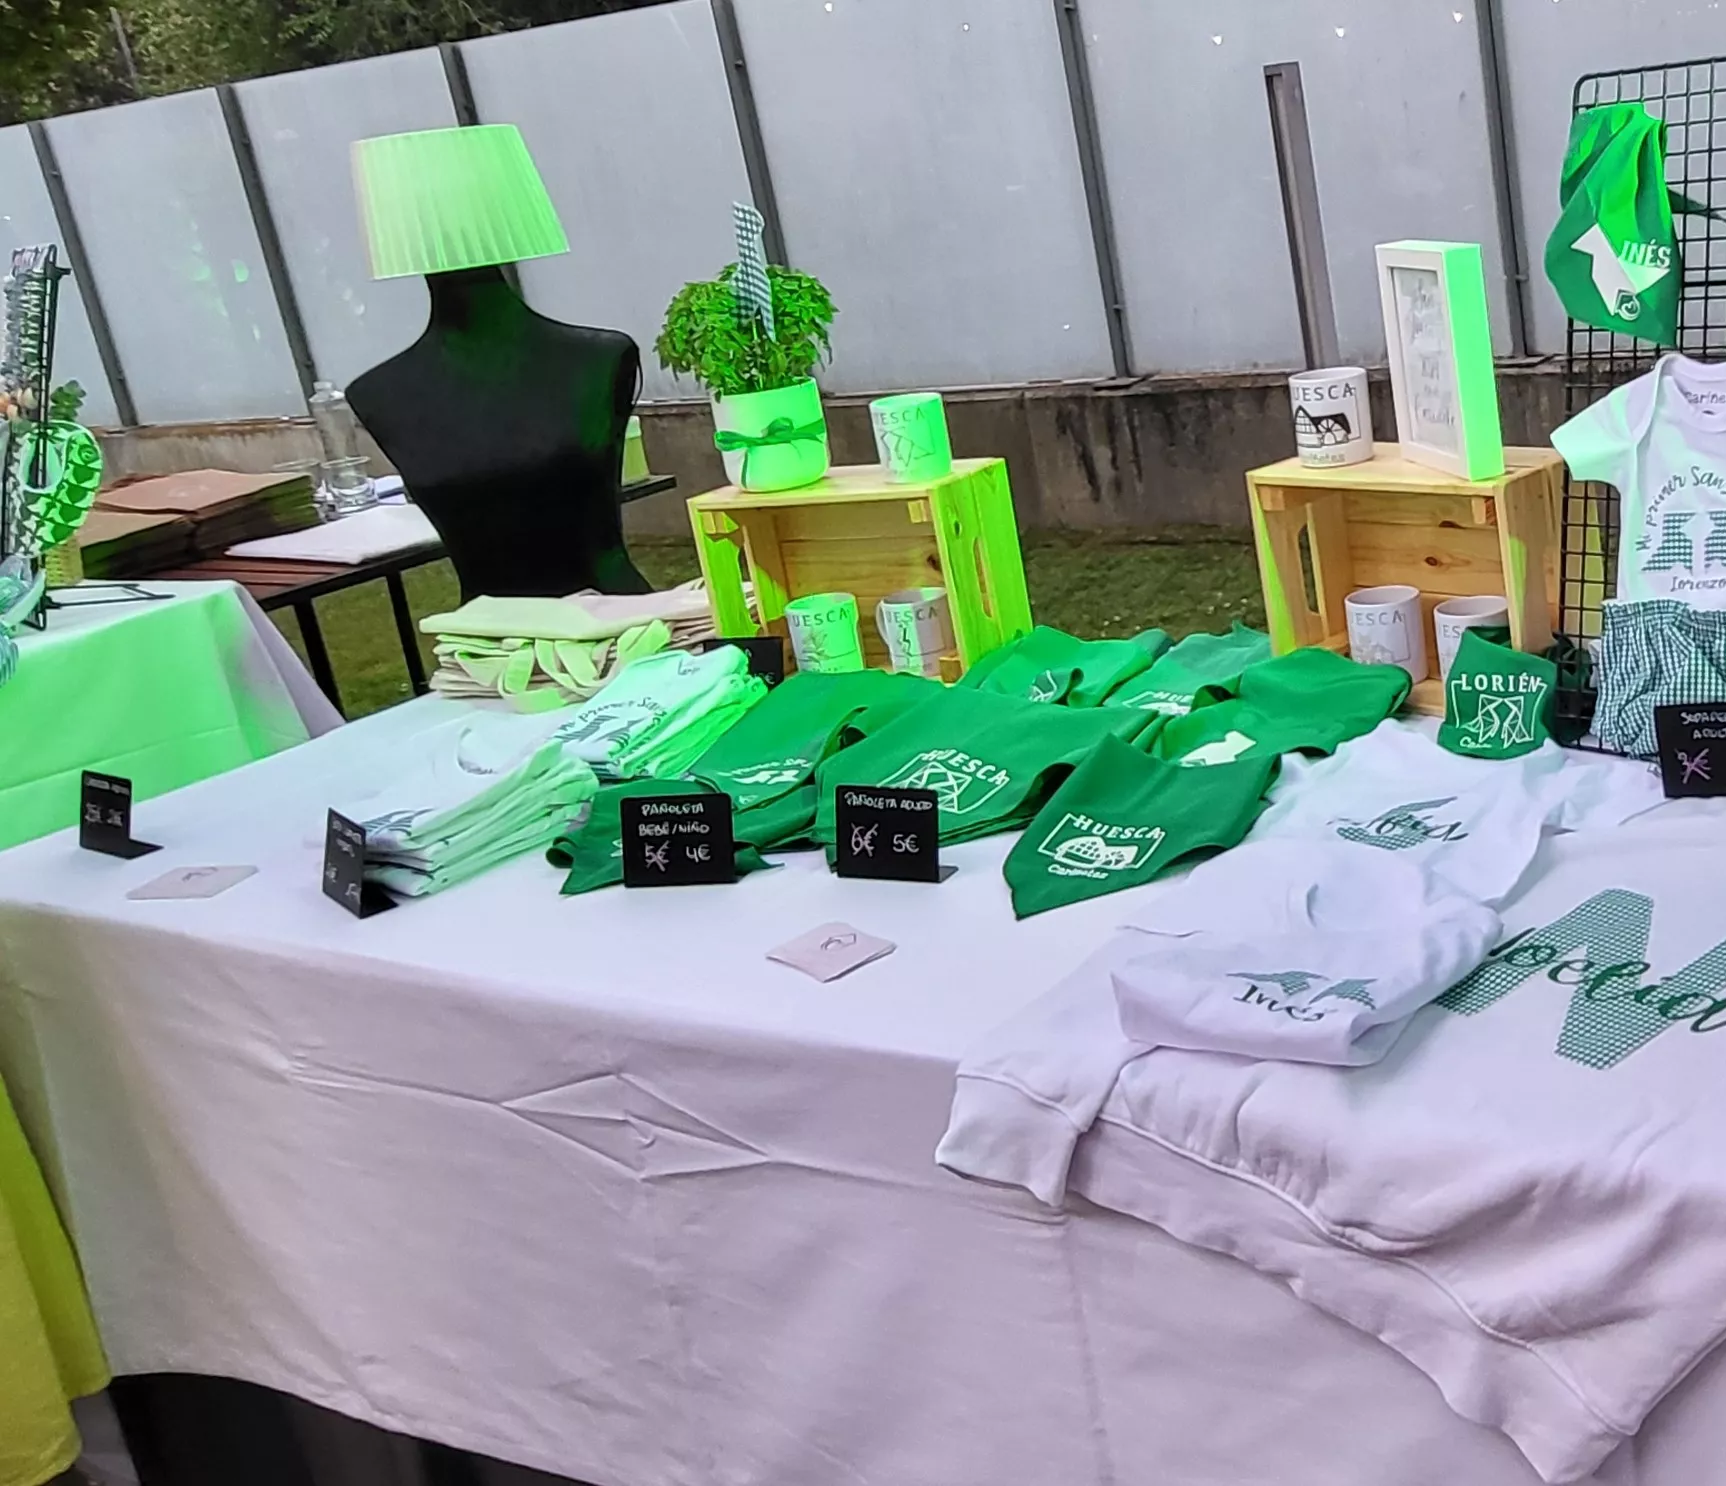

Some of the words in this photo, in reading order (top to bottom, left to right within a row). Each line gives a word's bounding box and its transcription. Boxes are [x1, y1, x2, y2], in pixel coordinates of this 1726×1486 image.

[1618, 239, 1672, 268] INÉS
[1645, 472, 1687, 527] primer
[1690, 465, 1725, 489] San
[1460, 672, 1542, 693] LORIÉN
[921, 749, 1010, 786] HUESCA
[1073, 814, 1162, 840] HUESCA
[685, 844, 711, 863] 4€
[892, 833, 920, 853] 5€
